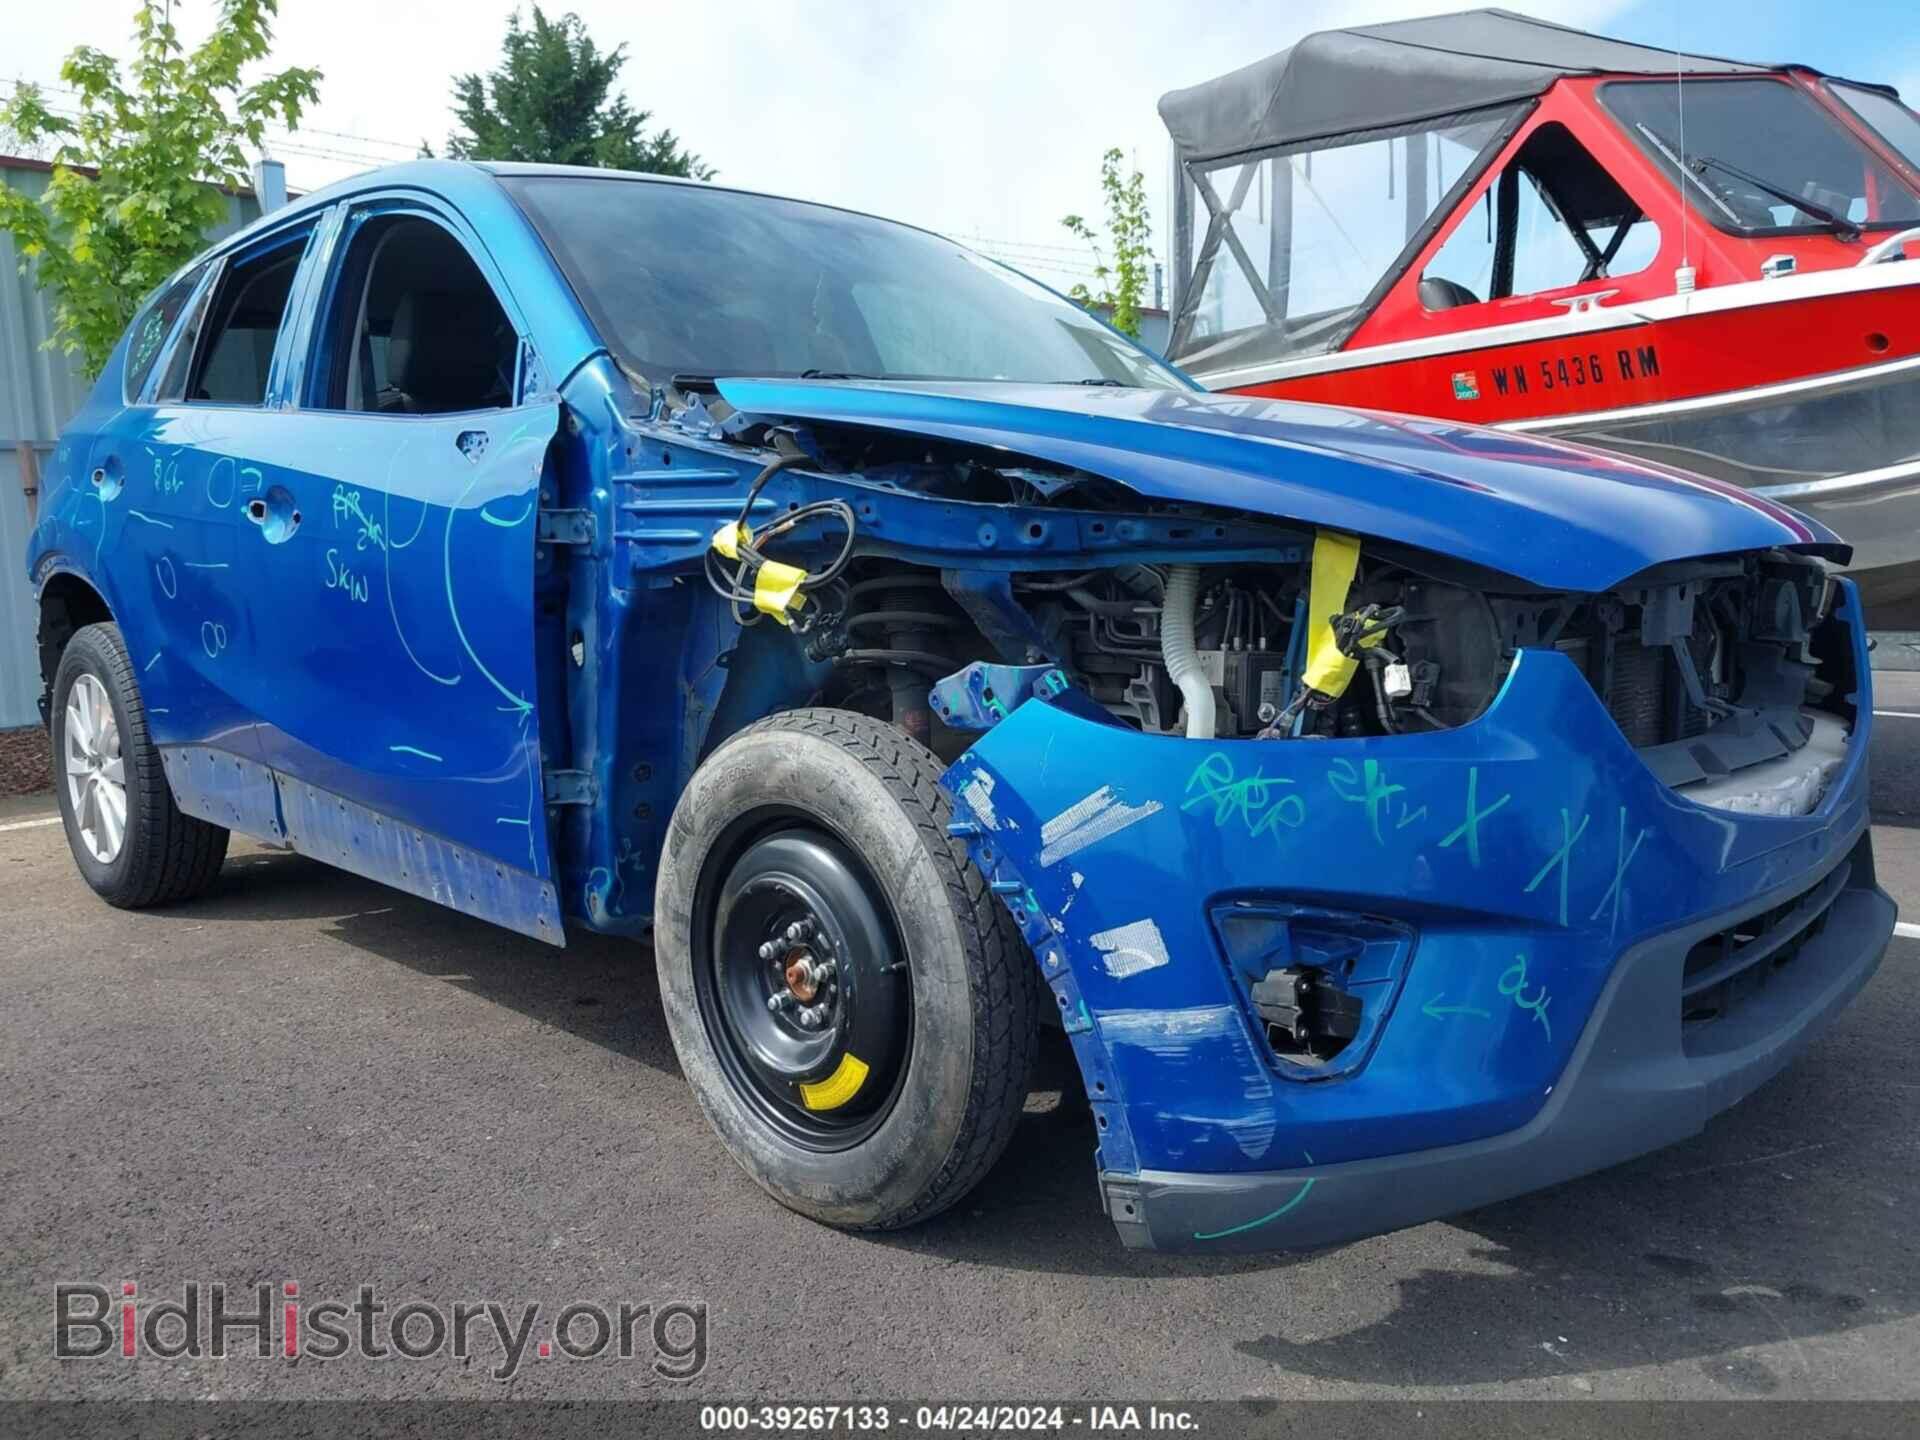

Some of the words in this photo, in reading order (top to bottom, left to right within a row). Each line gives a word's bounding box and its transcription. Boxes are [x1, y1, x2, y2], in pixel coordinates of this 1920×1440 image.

[1491, 364, 1528, 396] WN
[1540, 354, 1604, 389] 5436
[1617, 345, 1661, 381] RM
